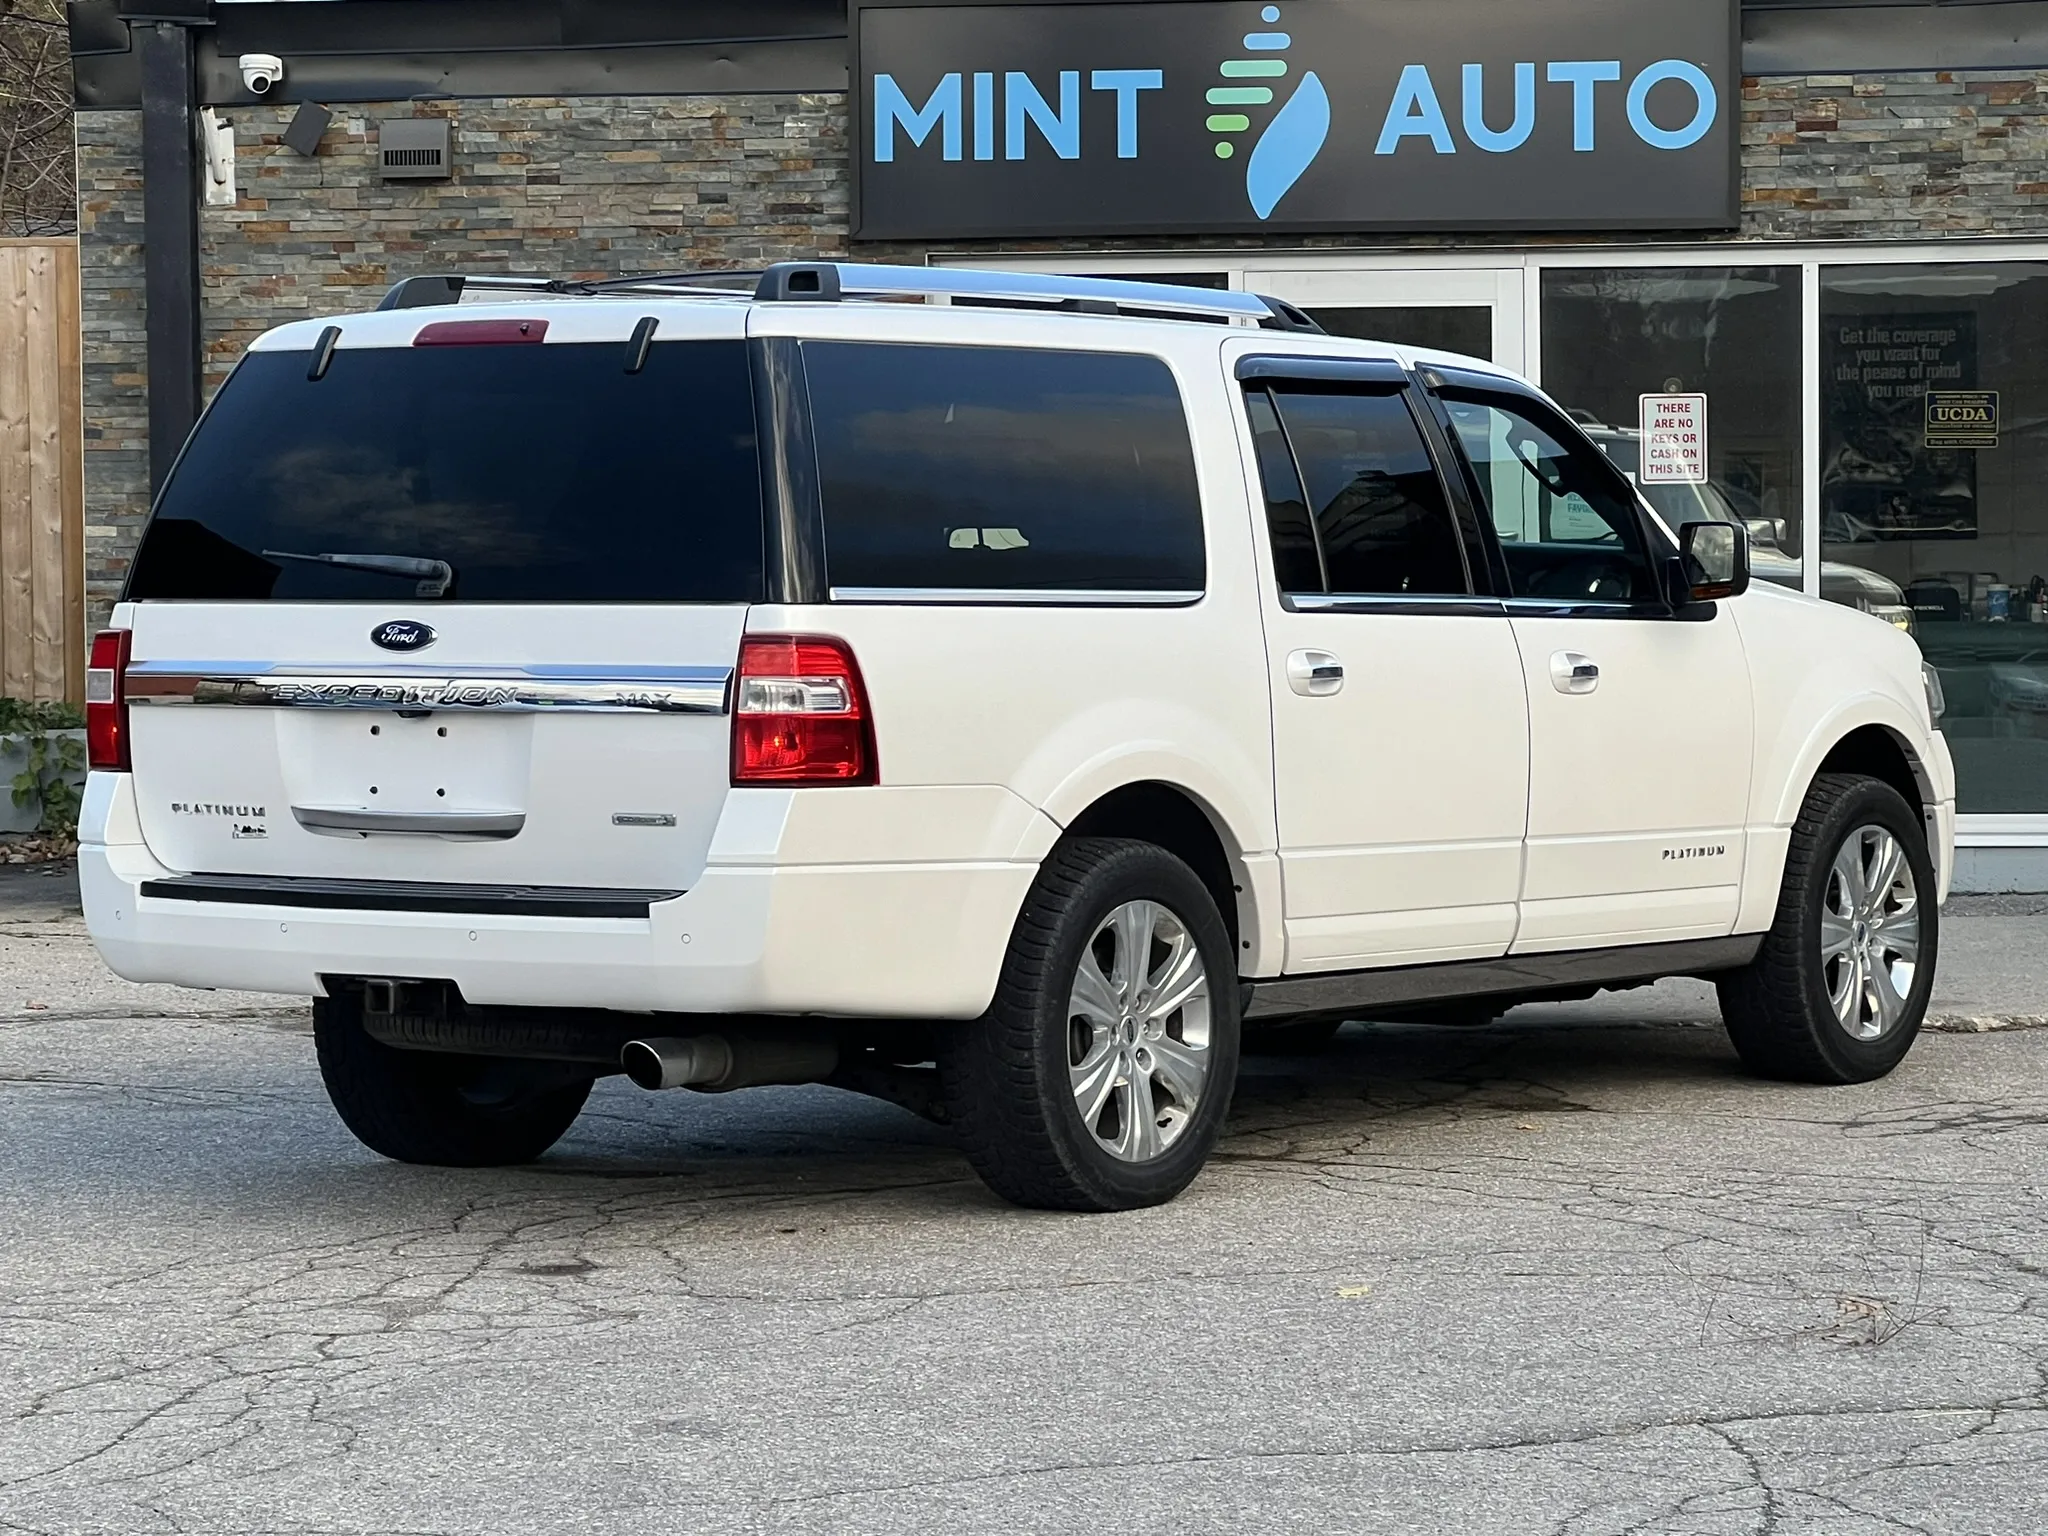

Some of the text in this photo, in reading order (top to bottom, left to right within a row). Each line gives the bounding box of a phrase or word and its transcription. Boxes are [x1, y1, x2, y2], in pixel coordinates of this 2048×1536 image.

[874, 60, 1717, 162] MINT AUTO
[1840, 327, 1957, 346] Get the coverage
[1855, 343, 1941, 365] you want for
[1836, 361, 1961, 383] the peace of mind
[1867, 384, 1892, 402] you
[1656, 403, 1691, 413] THERE
[1936, 407, 1989, 421] UCDA
[1654, 418, 1693, 428] ARE NO
[1651, 433, 1697, 444] KEYS OR
[1650, 448, 1697, 459] CASH ON
[1649, 463, 1699, 474] THIS SITE
[381, 624, 419, 643] Ford
[272, 683, 672, 706] EXPEDITION MAX
[171, 803, 267, 818] PLATINUM
[1661, 845, 1725, 860] PLATINUM
